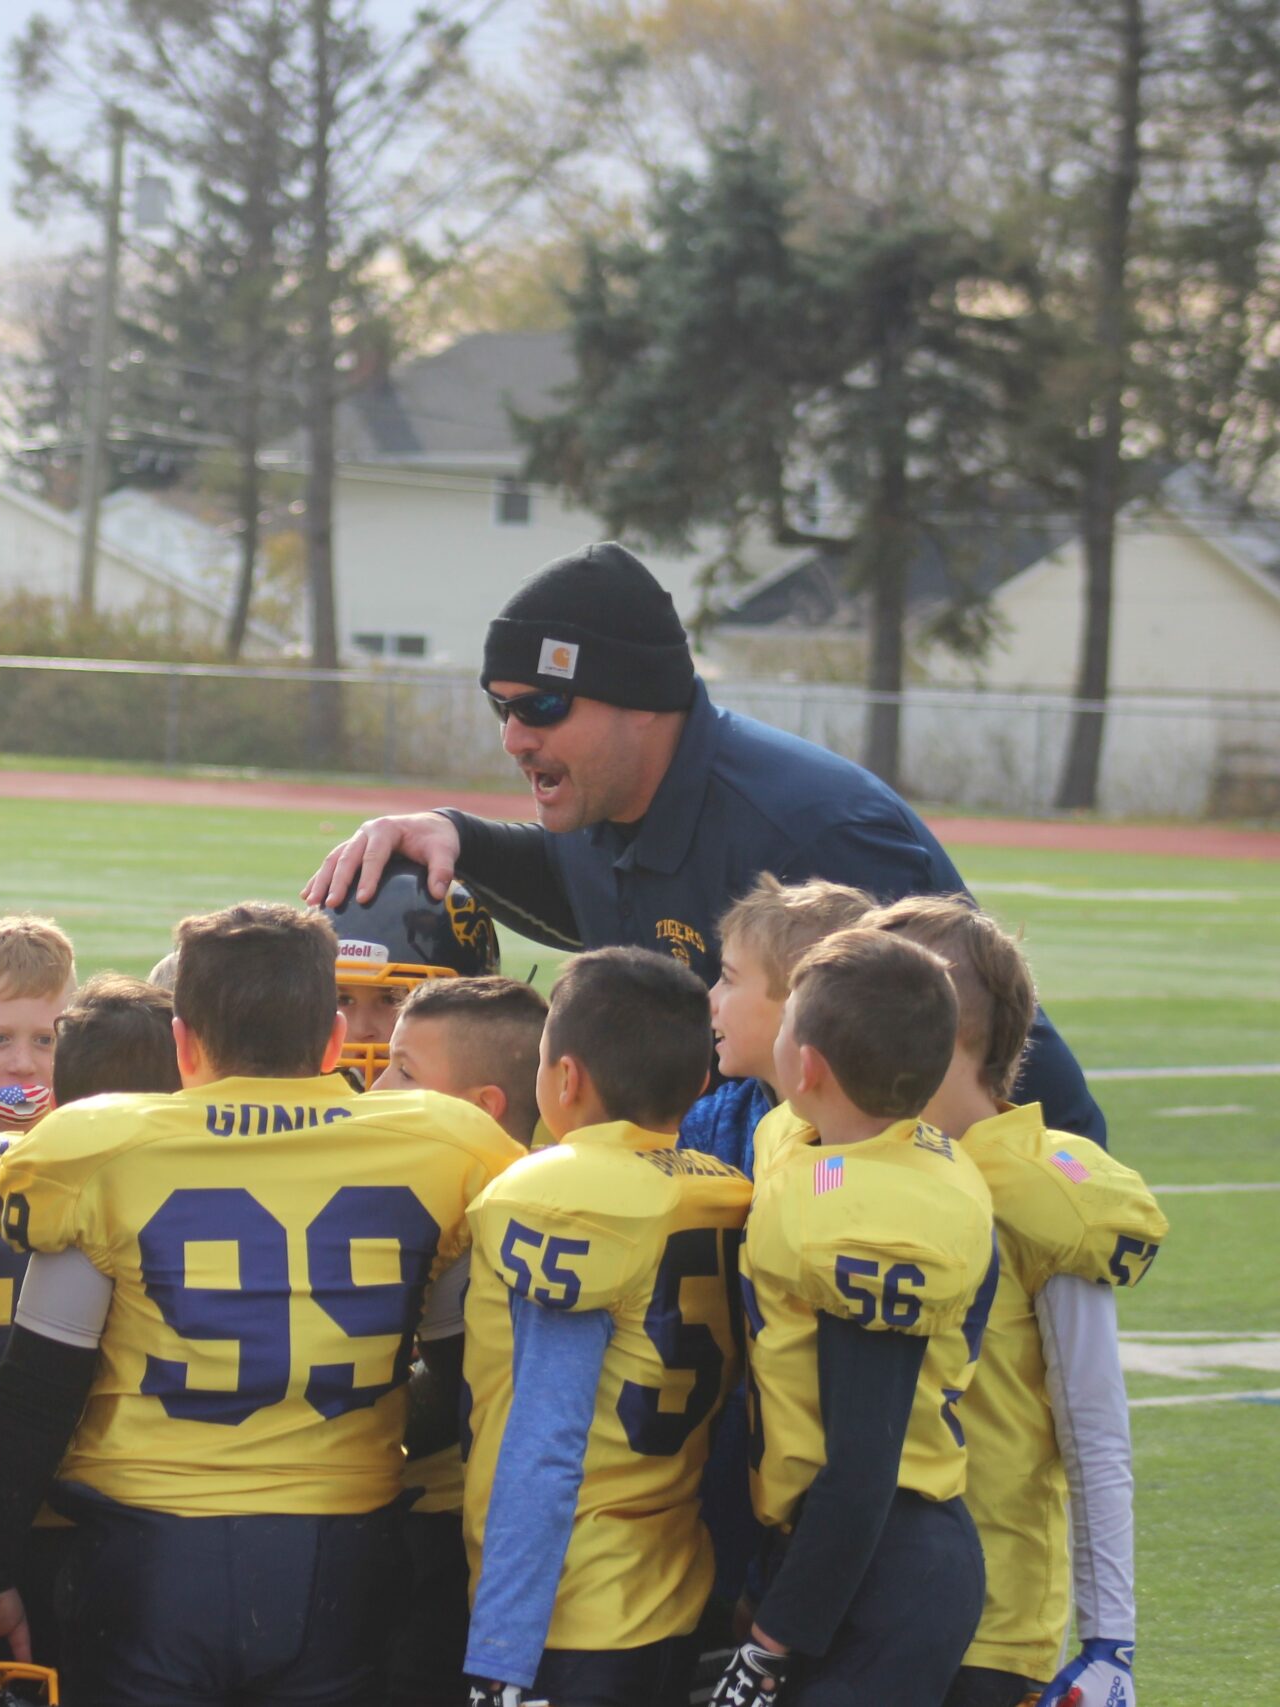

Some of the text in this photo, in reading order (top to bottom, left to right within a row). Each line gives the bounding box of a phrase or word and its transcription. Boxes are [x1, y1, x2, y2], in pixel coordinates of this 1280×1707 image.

[337, 944, 371, 957] ddell
[656, 919, 705, 953] TIGERS
[495, 1218, 589, 1309] 55
[835, 1255, 926, 1327] 56
[137, 1186, 441, 1426] 99
